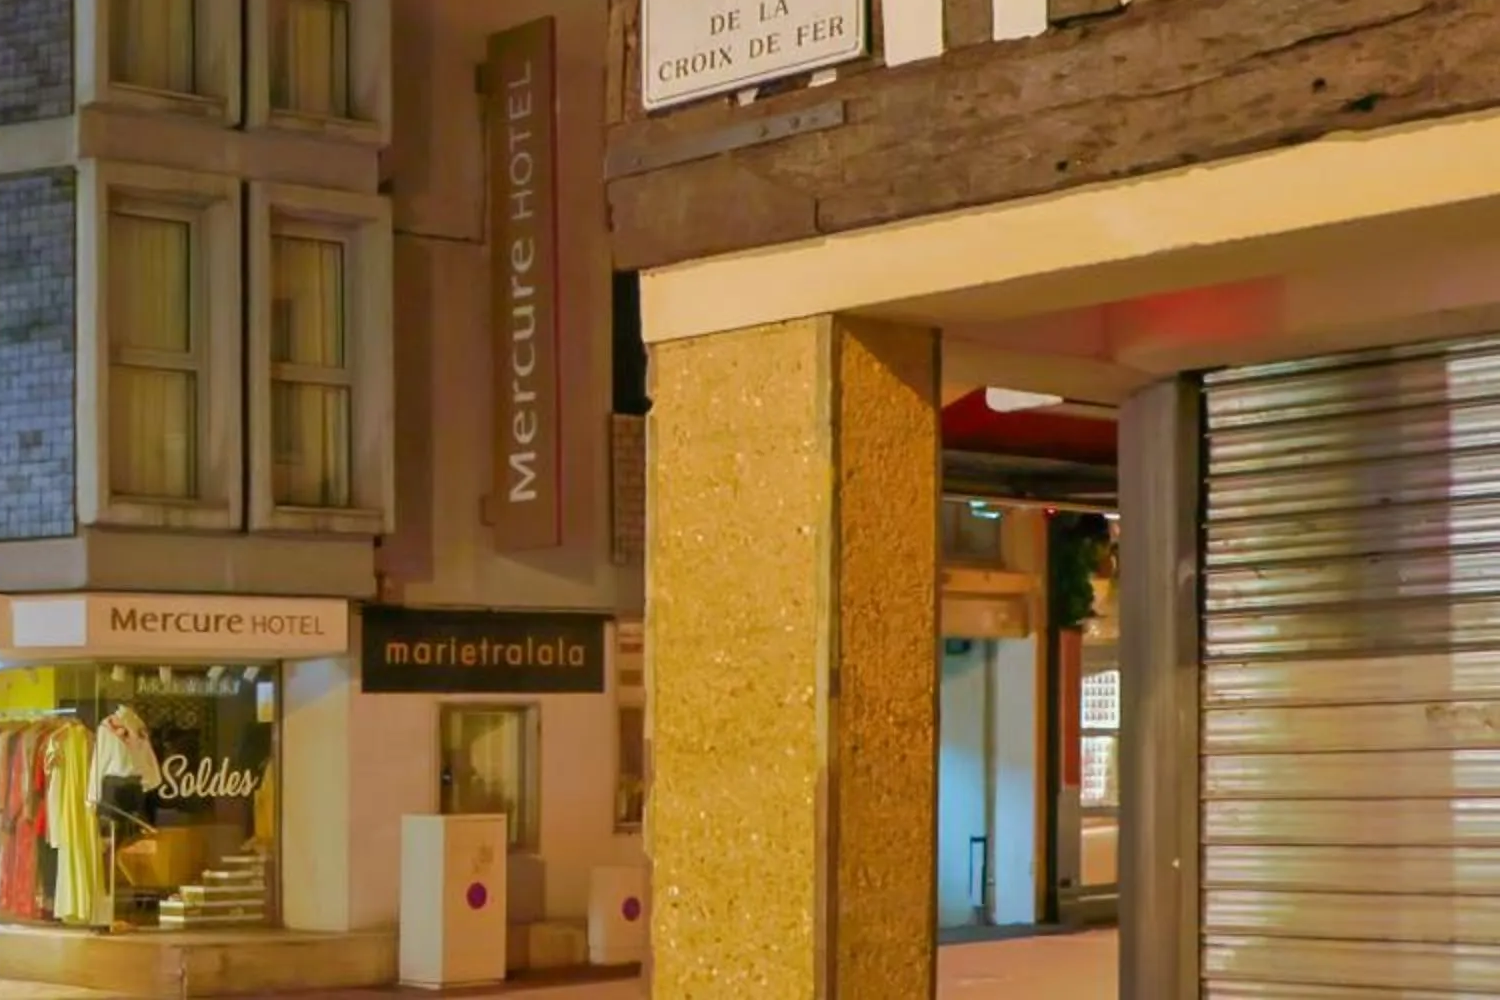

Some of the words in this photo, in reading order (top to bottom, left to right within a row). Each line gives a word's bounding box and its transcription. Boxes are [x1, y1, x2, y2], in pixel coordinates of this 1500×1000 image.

[710, 9, 741, 36] DE
[658, 45, 733, 83] CROIX
[749, 32, 781, 59] DE
[796, 15, 844, 47] FER
[508, 60, 535, 221] HOTEL
[508, 237, 538, 503] Mercure
[111, 607, 244, 634] Mercure
[251, 615, 325, 636] HOTEL
[385, 636, 585, 666] marietralala
[158, 754, 259, 800] Soldes
